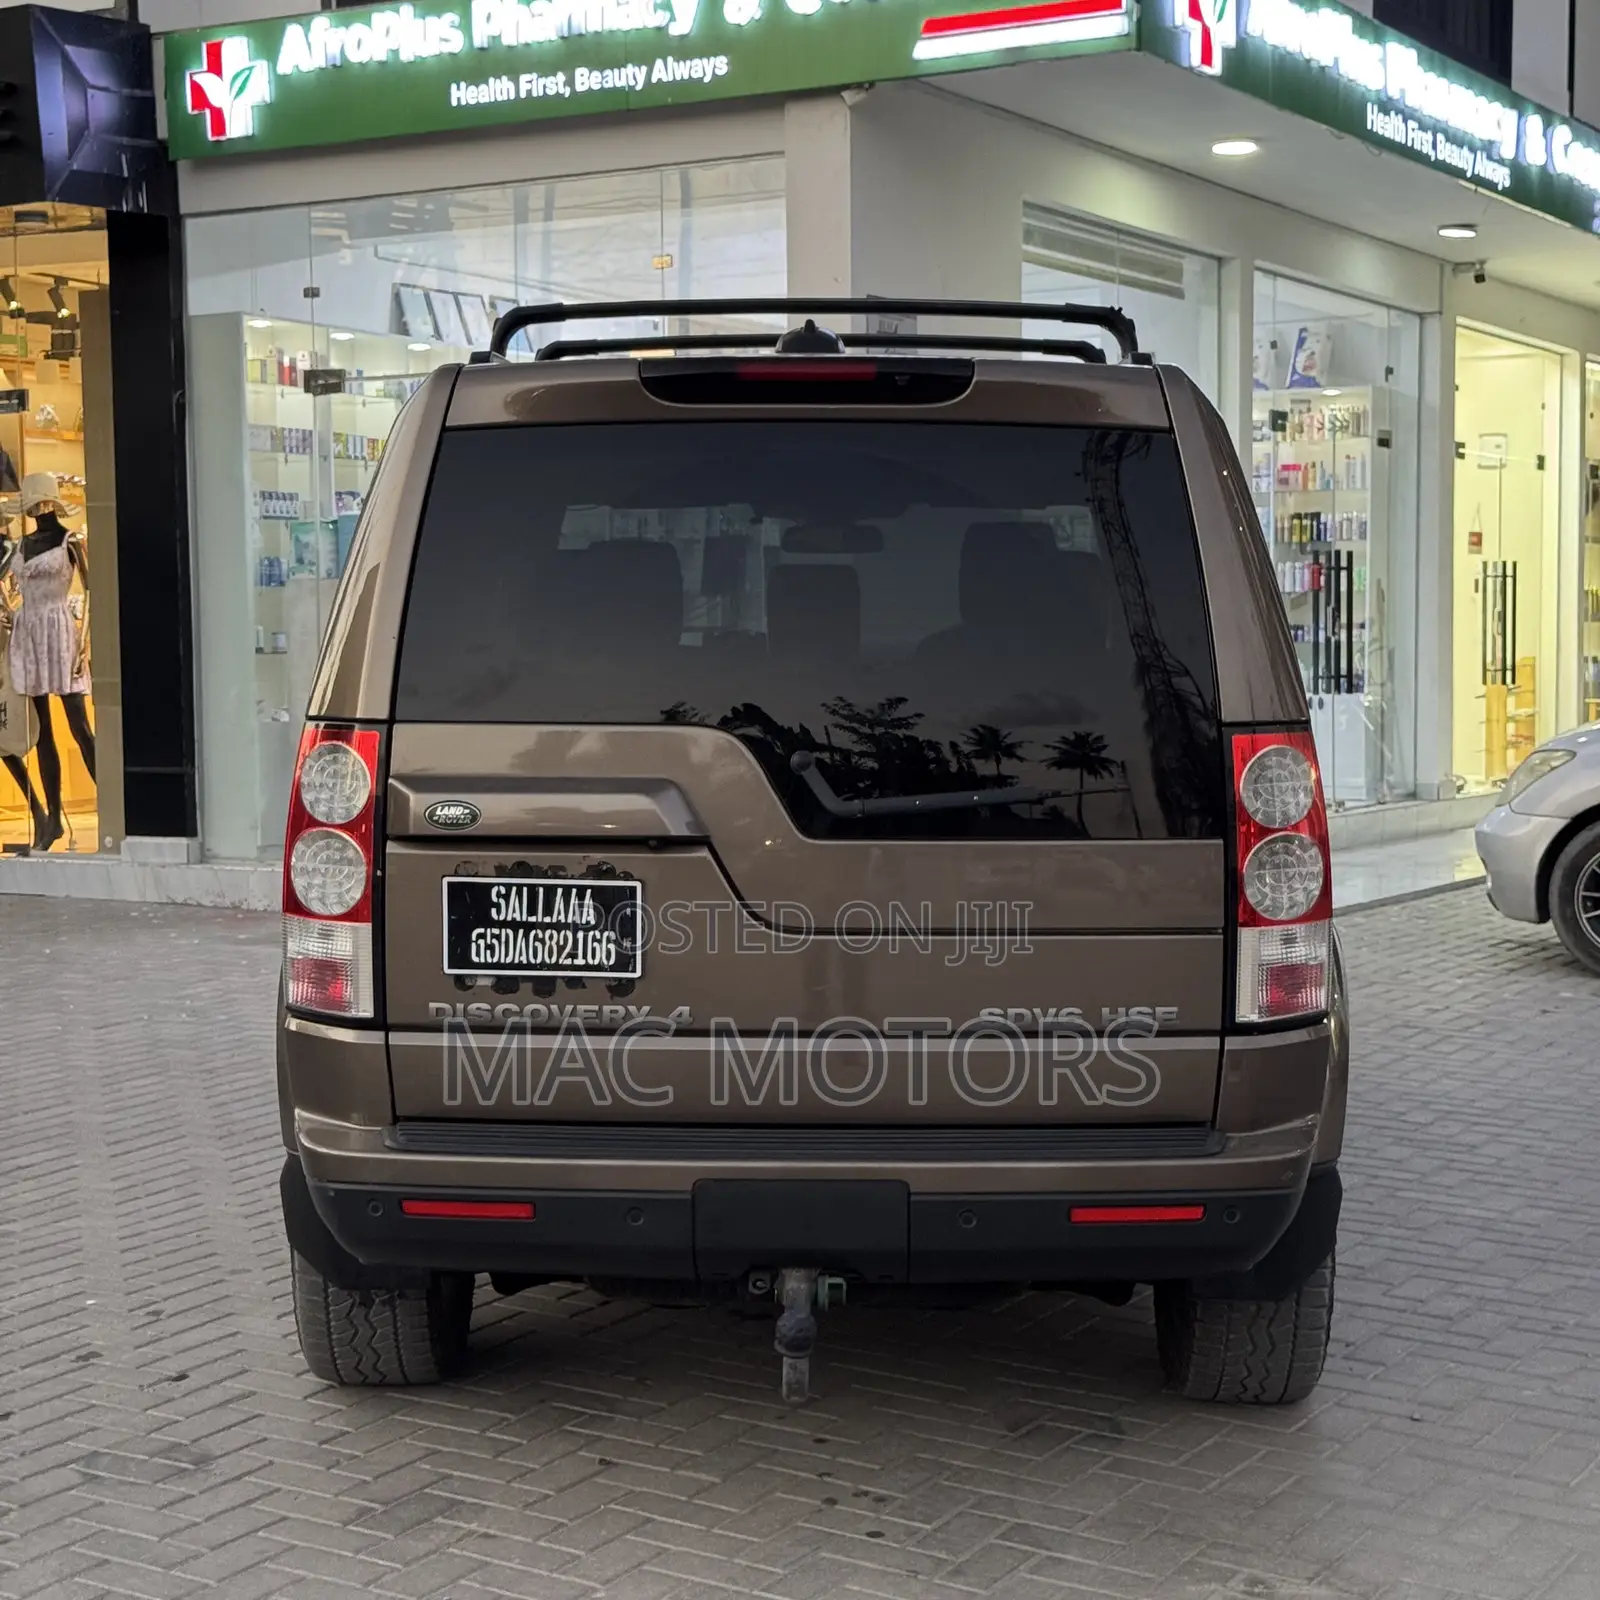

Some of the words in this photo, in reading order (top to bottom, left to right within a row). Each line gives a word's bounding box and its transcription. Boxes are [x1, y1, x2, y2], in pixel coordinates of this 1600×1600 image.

[276, 2, 465, 76] AfroPlus
[471, 0, 700, 49] Pharmacy
[450, 73, 516, 107] Health
[519, 71, 570, 98] First,
[574, 62, 648, 91] Beauty
[651, 53, 729, 83] Always
[1366, 101, 1407, 145] Health
[1406, 119, 1436, 162] First,
[1436, 132, 1475, 179] Beauty
[1474, 149, 1511, 191] Always
[435, 805, 464, 815] LAND
[438, 814, 473, 824] ROVER
[490, 885, 597, 925] SALLAAA
[470, 926, 617, 966] G5DA682166
[428, 1001, 653, 1026] DISCOVERY
[669, 1005, 694, 1026] 4
[1101, 1006, 1180, 1027] HSE
